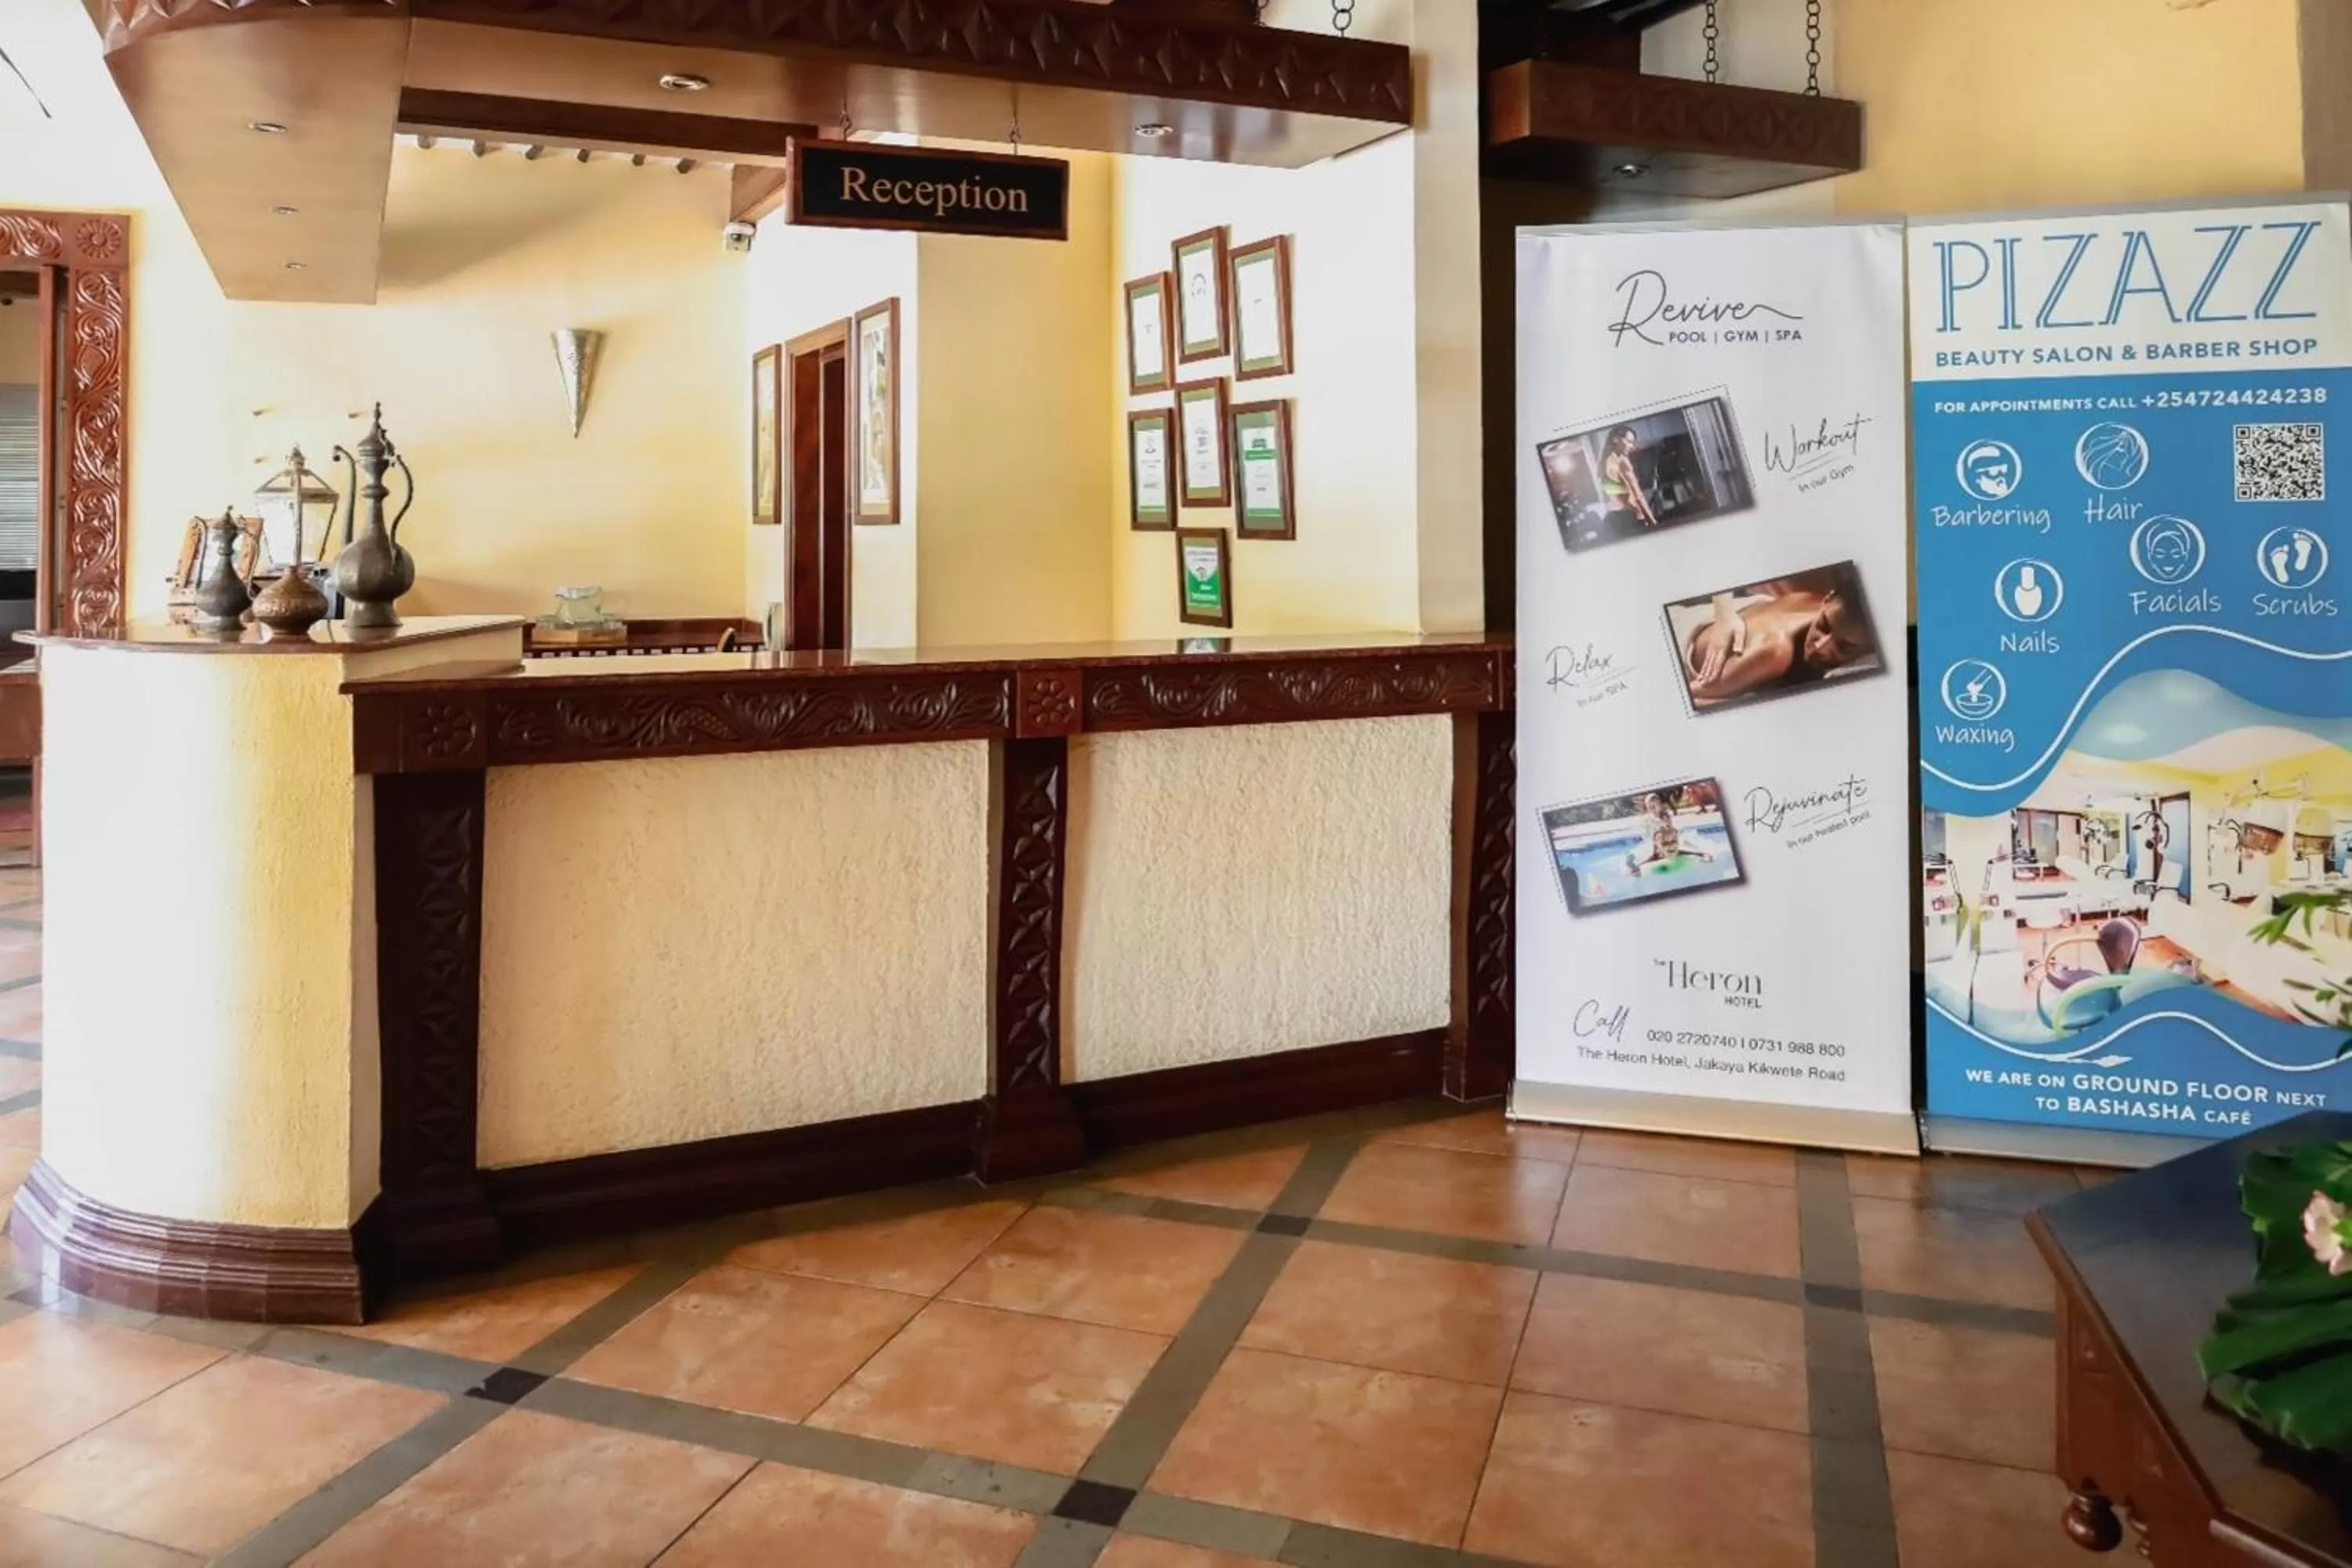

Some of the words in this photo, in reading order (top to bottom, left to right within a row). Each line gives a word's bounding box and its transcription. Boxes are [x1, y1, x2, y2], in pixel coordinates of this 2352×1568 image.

[840, 166, 1028, 216] Reception
[1933, 220, 2321, 332] PIZAZZ
[1608, 270, 1803, 347] Revive
[1669, 331, 1706, 343] POOL
[1724, 330, 1759, 343] GYM
[1775, 329, 1802, 341] SPA
[1936, 350, 2025, 367] BEAUTY
[2033, 345, 2112, 363] SALON
[2122, 344, 2137, 361] &
[2147, 341, 2241, 360] BARBER
[2249, 339, 2318, 357] SHOP
[1934, 401, 1966, 414] FOR
[1969, 397, 2092, 413] APPOINTMENTS
[2097, 397, 2136, 409] CALL
[2141, 387, 2327, 408] +254724424238
[1765, 412, 1872, 473] Workout
[1931, 505, 2051, 533] Barbering
[2084, 494, 2143, 523] Hair
[2129, 589, 2222, 615] Facials
[2252, 593, 2338, 617] Scrubs
[2000, 632, 2060, 653] Nails
[1544, 643, 1617, 694] Relax
[1935, 724, 2015, 753] Waxing
[1669, 960, 1762, 994] Heron
[1724, 996, 1762, 1009] HOTEL
[1573, 999, 1631, 1042] Call
[1646, 1029, 1672, 1043] 020
[1676, 1032, 1737, 1048] 2720740
[1748, 1038, 1783, 1051] 0731
[1788, 1040, 1815, 1054] 988
[1818, 1044, 1845, 1057] 800
[1577, 1046, 1602, 1059] The
[1607, 1048, 1646, 1064] Heron
[1694, 1058, 1744, 1074] Jakaya
[1748, 1062, 1802, 1077] Kikwete
[1808, 1066, 1845, 1081] Road
[1965, 1069, 1993, 1083] WE
[1998, 1071, 2032, 1086] ARE
[2038, 1073, 2065, 1088] ON
[2073, 1074, 2179, 1097] GROUND
[2187, 1082, 2267, 1103] FLOOR
[2276, 1091, 2326, 1107] NEXT
[2035, 1097, 2060, 1111] TO
[2067, 1097, 2196, 1121] BASHASHA
[2205, 1109, 2252, 1126] CAFÉ
